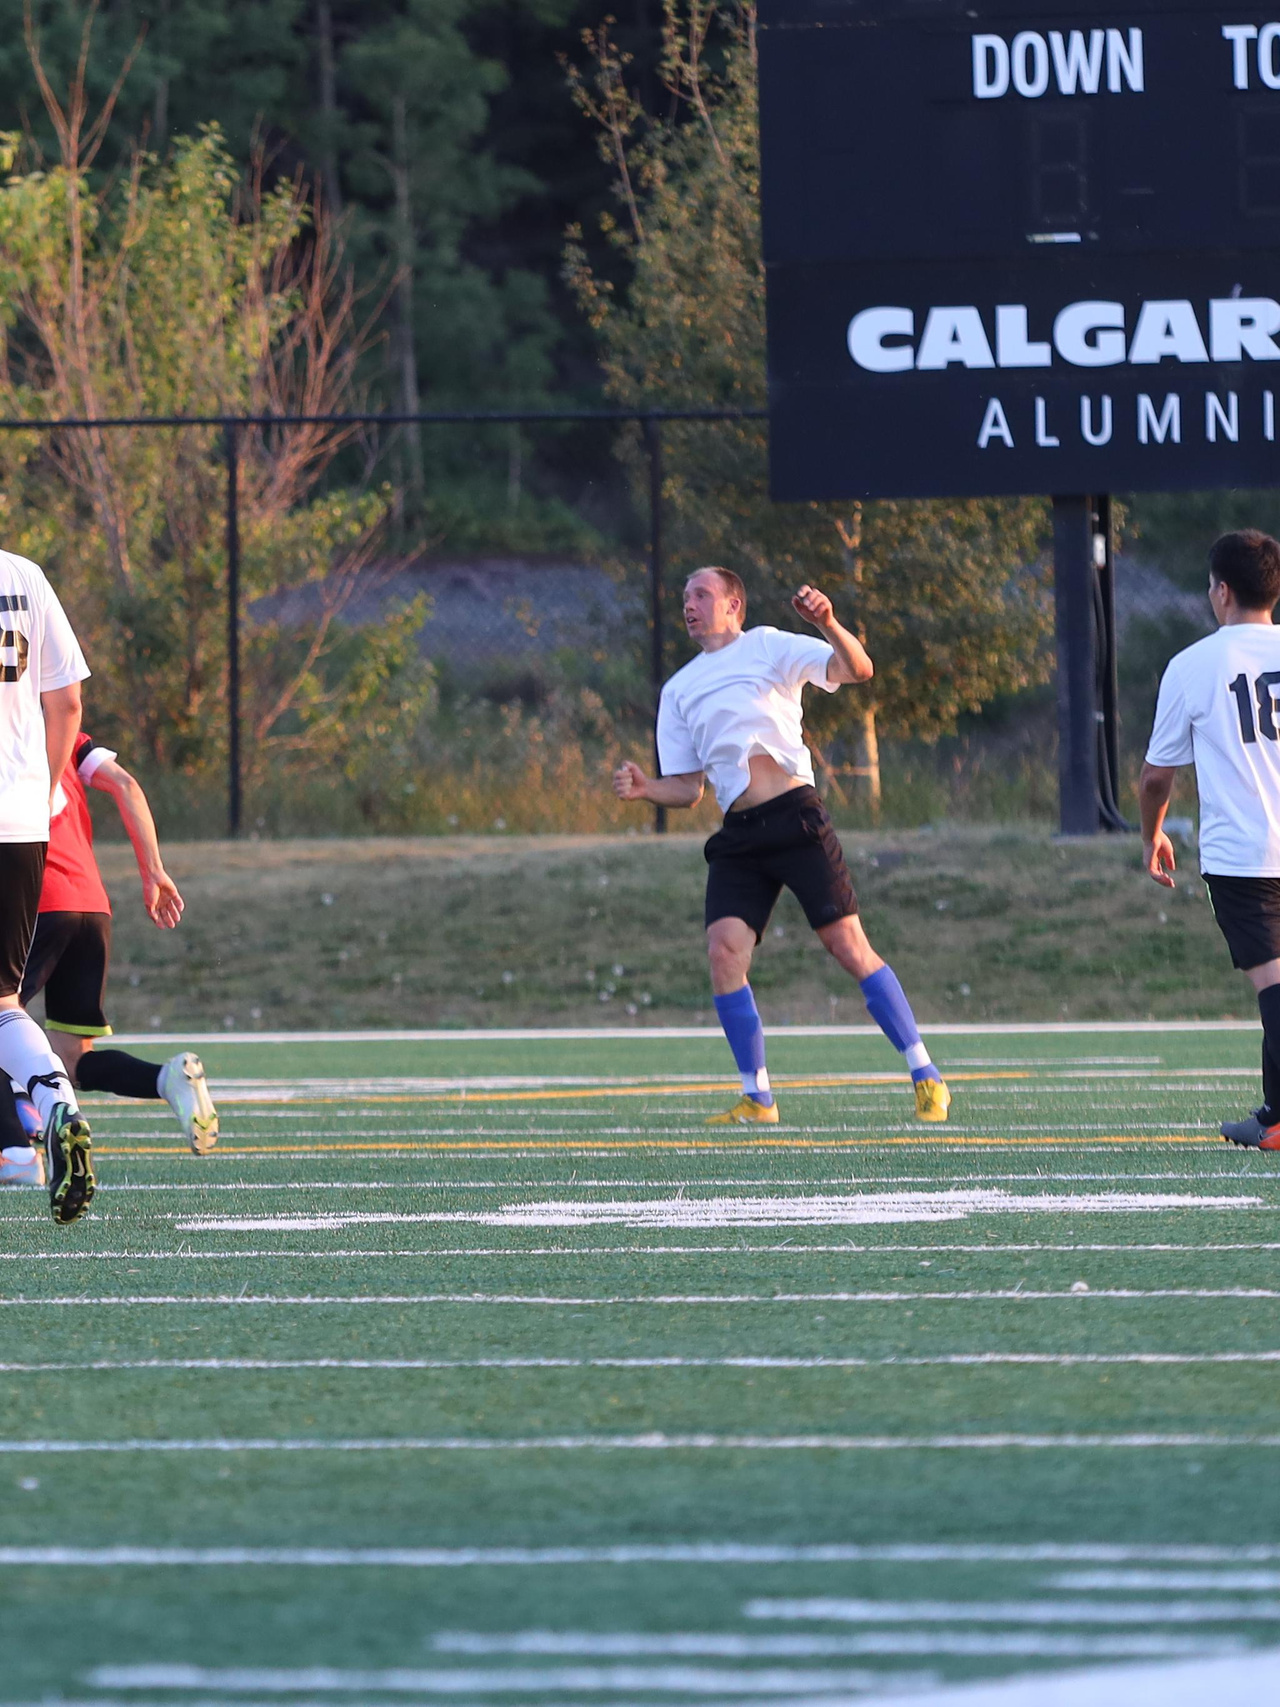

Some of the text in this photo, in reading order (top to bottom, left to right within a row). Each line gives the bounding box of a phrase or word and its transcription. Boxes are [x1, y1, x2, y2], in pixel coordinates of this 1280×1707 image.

[972, 27, 1144, 98] DOWN
[847, 298, 1280, 373] CALGAR
[977, 391, 1274, 449] ALUMNI
